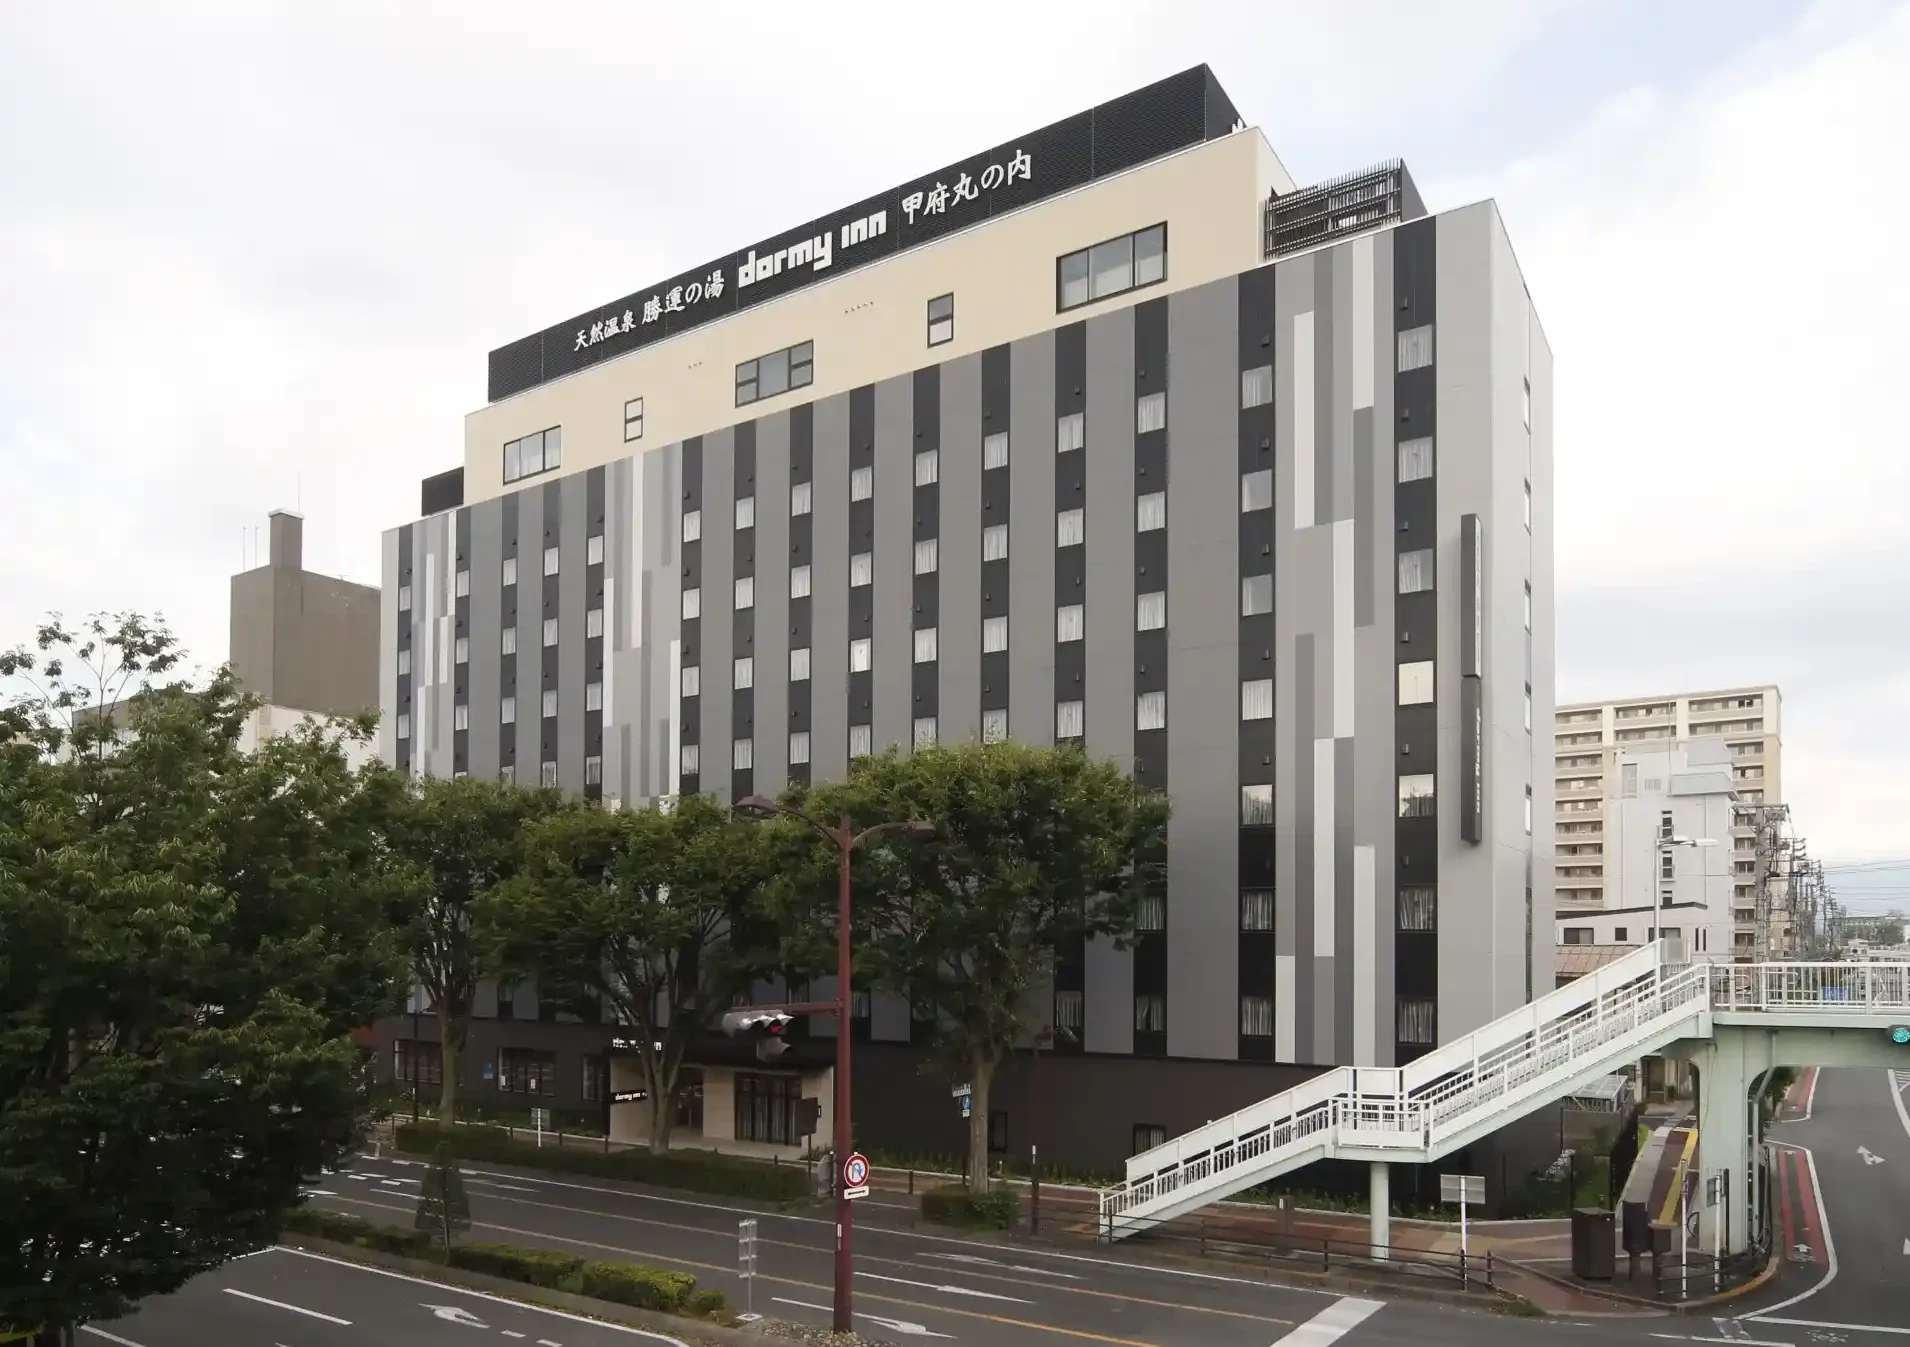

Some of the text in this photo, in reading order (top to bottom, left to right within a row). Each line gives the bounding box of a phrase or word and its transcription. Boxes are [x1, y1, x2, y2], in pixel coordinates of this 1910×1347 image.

[574, 149, 1032, 351] 天然温泉 勝運の湯 dormy inn 甲府丸の内
